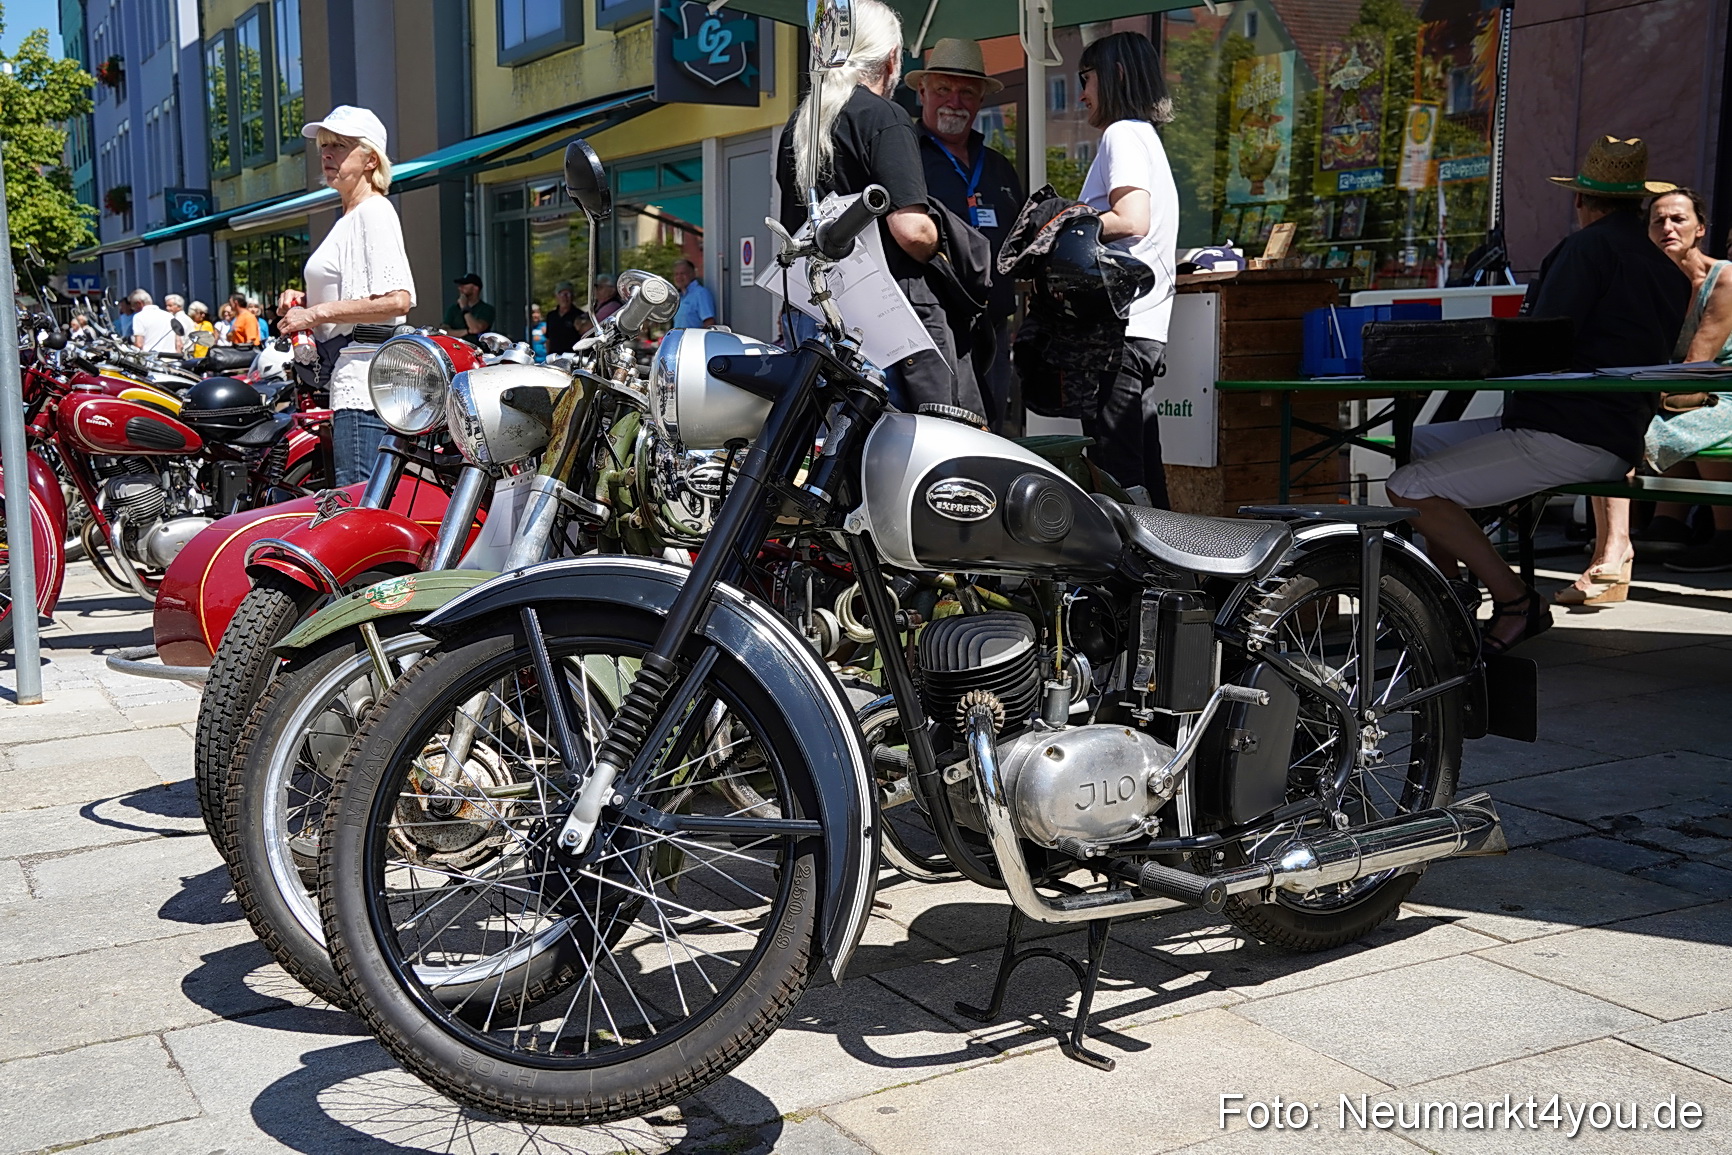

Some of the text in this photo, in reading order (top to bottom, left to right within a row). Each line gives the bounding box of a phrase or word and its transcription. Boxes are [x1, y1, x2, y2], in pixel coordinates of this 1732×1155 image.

[697, 18, 733, 65] G2
[182, 200, 199, 219] G2
[1156, 399, 1193, 417] chaft
[936, 501, 984, 514] EXPRESS
[1074, 775, 1136, 811] JLO
